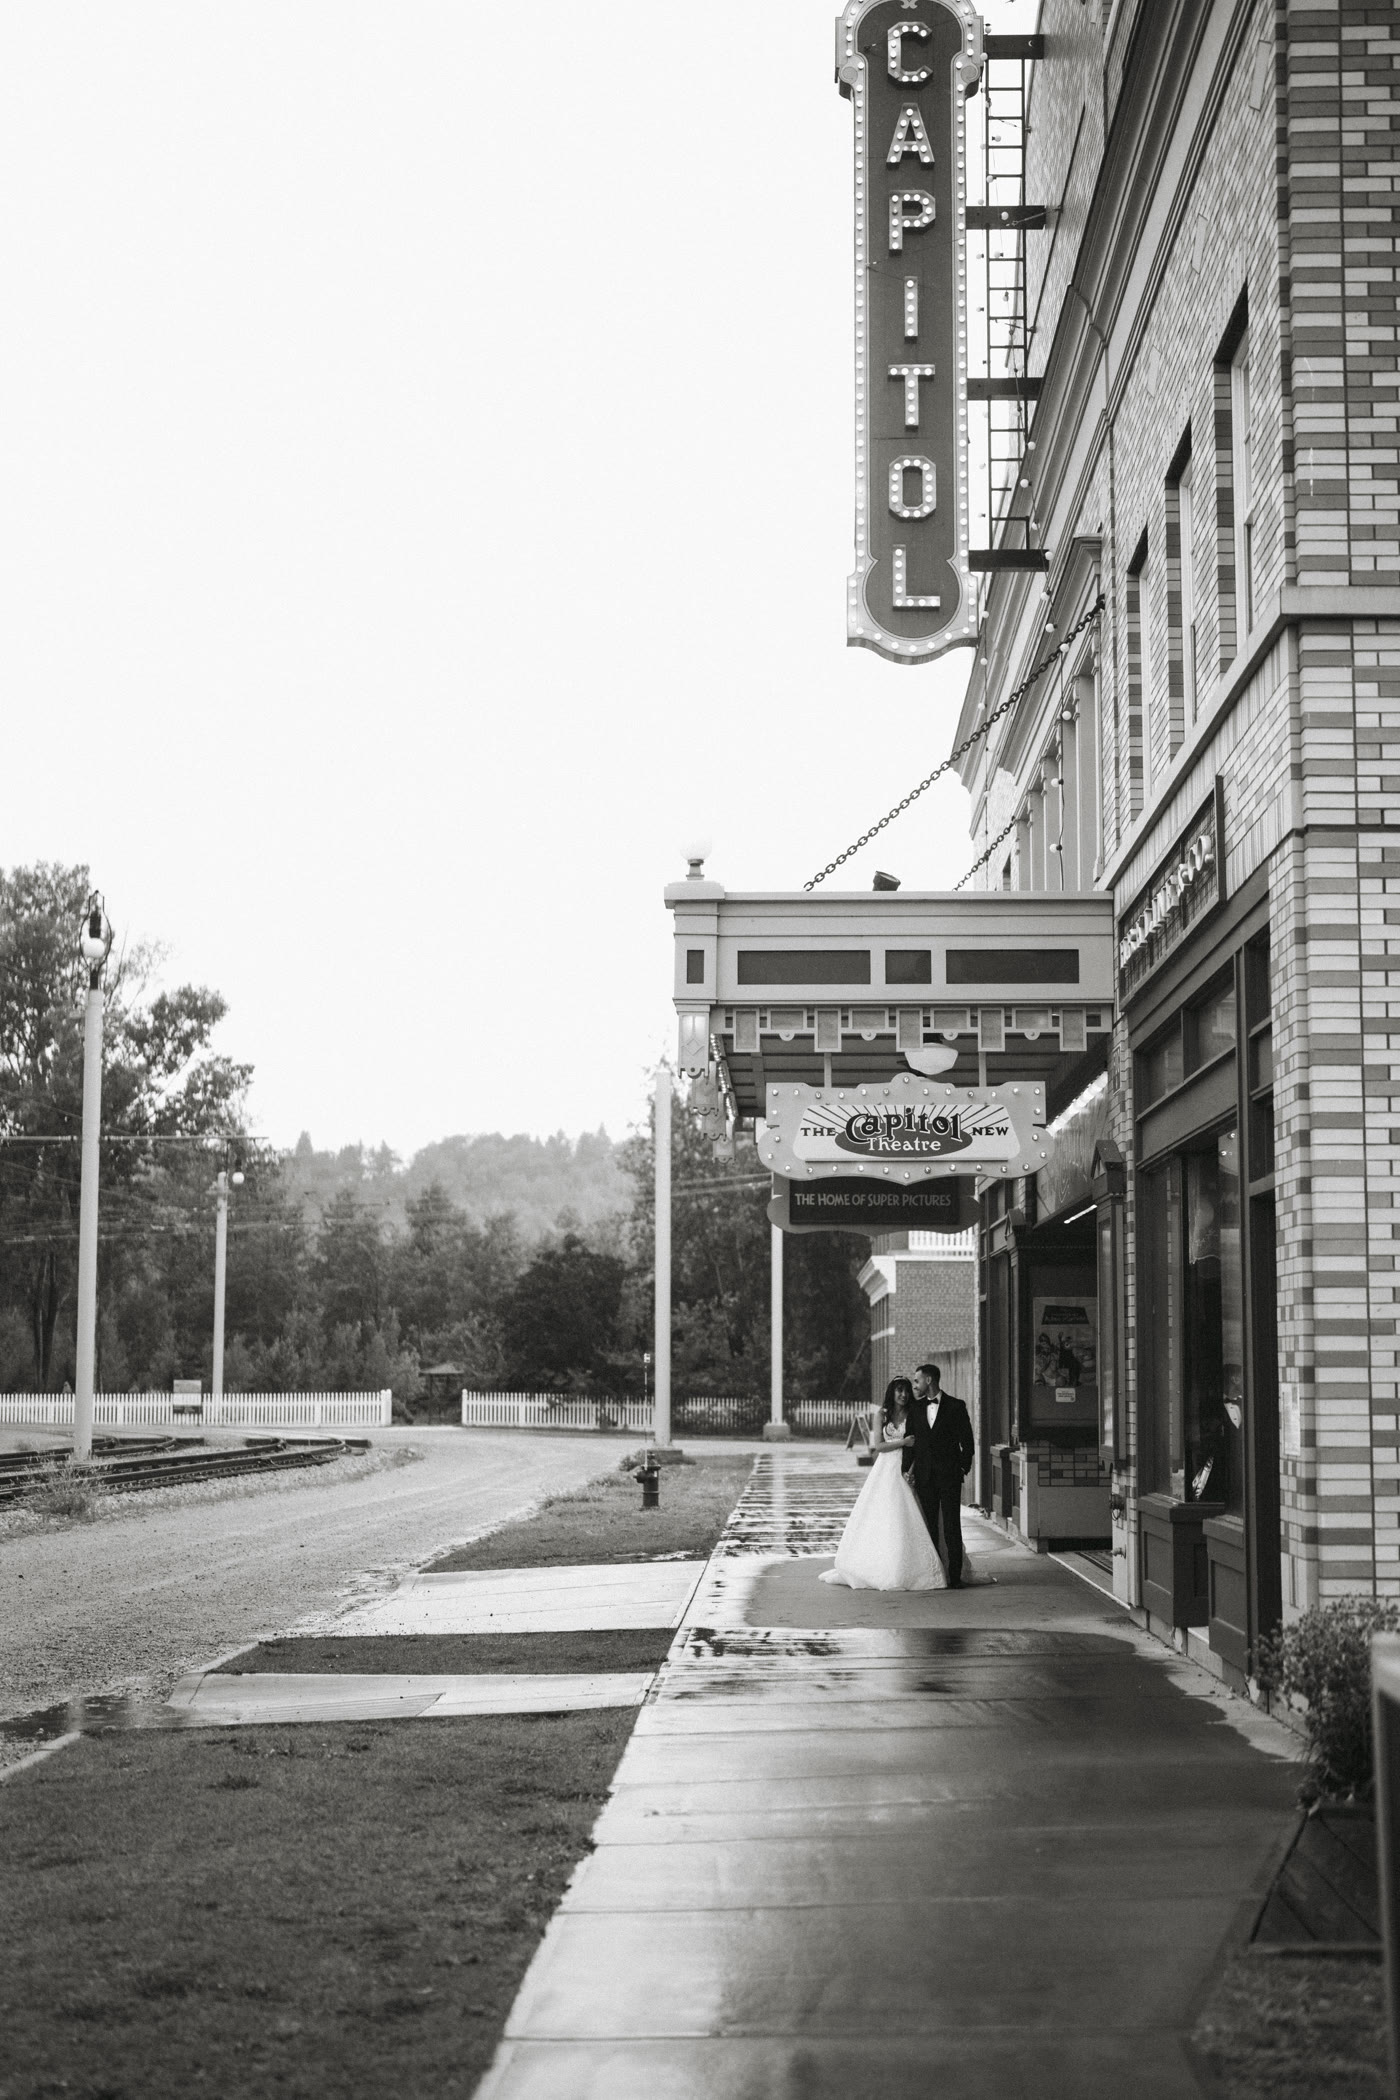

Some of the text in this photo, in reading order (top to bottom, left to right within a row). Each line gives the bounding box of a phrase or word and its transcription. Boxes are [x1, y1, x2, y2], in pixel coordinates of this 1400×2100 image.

[886, 21, 941, 608] CAPITOL
[800, 1107, 1009, 1144] THE Capitol NEW
[866, 1136, 942, 1151] Theatre
[794, 1193, 952, 1207] THE HOME OF SUPER PICTURES
